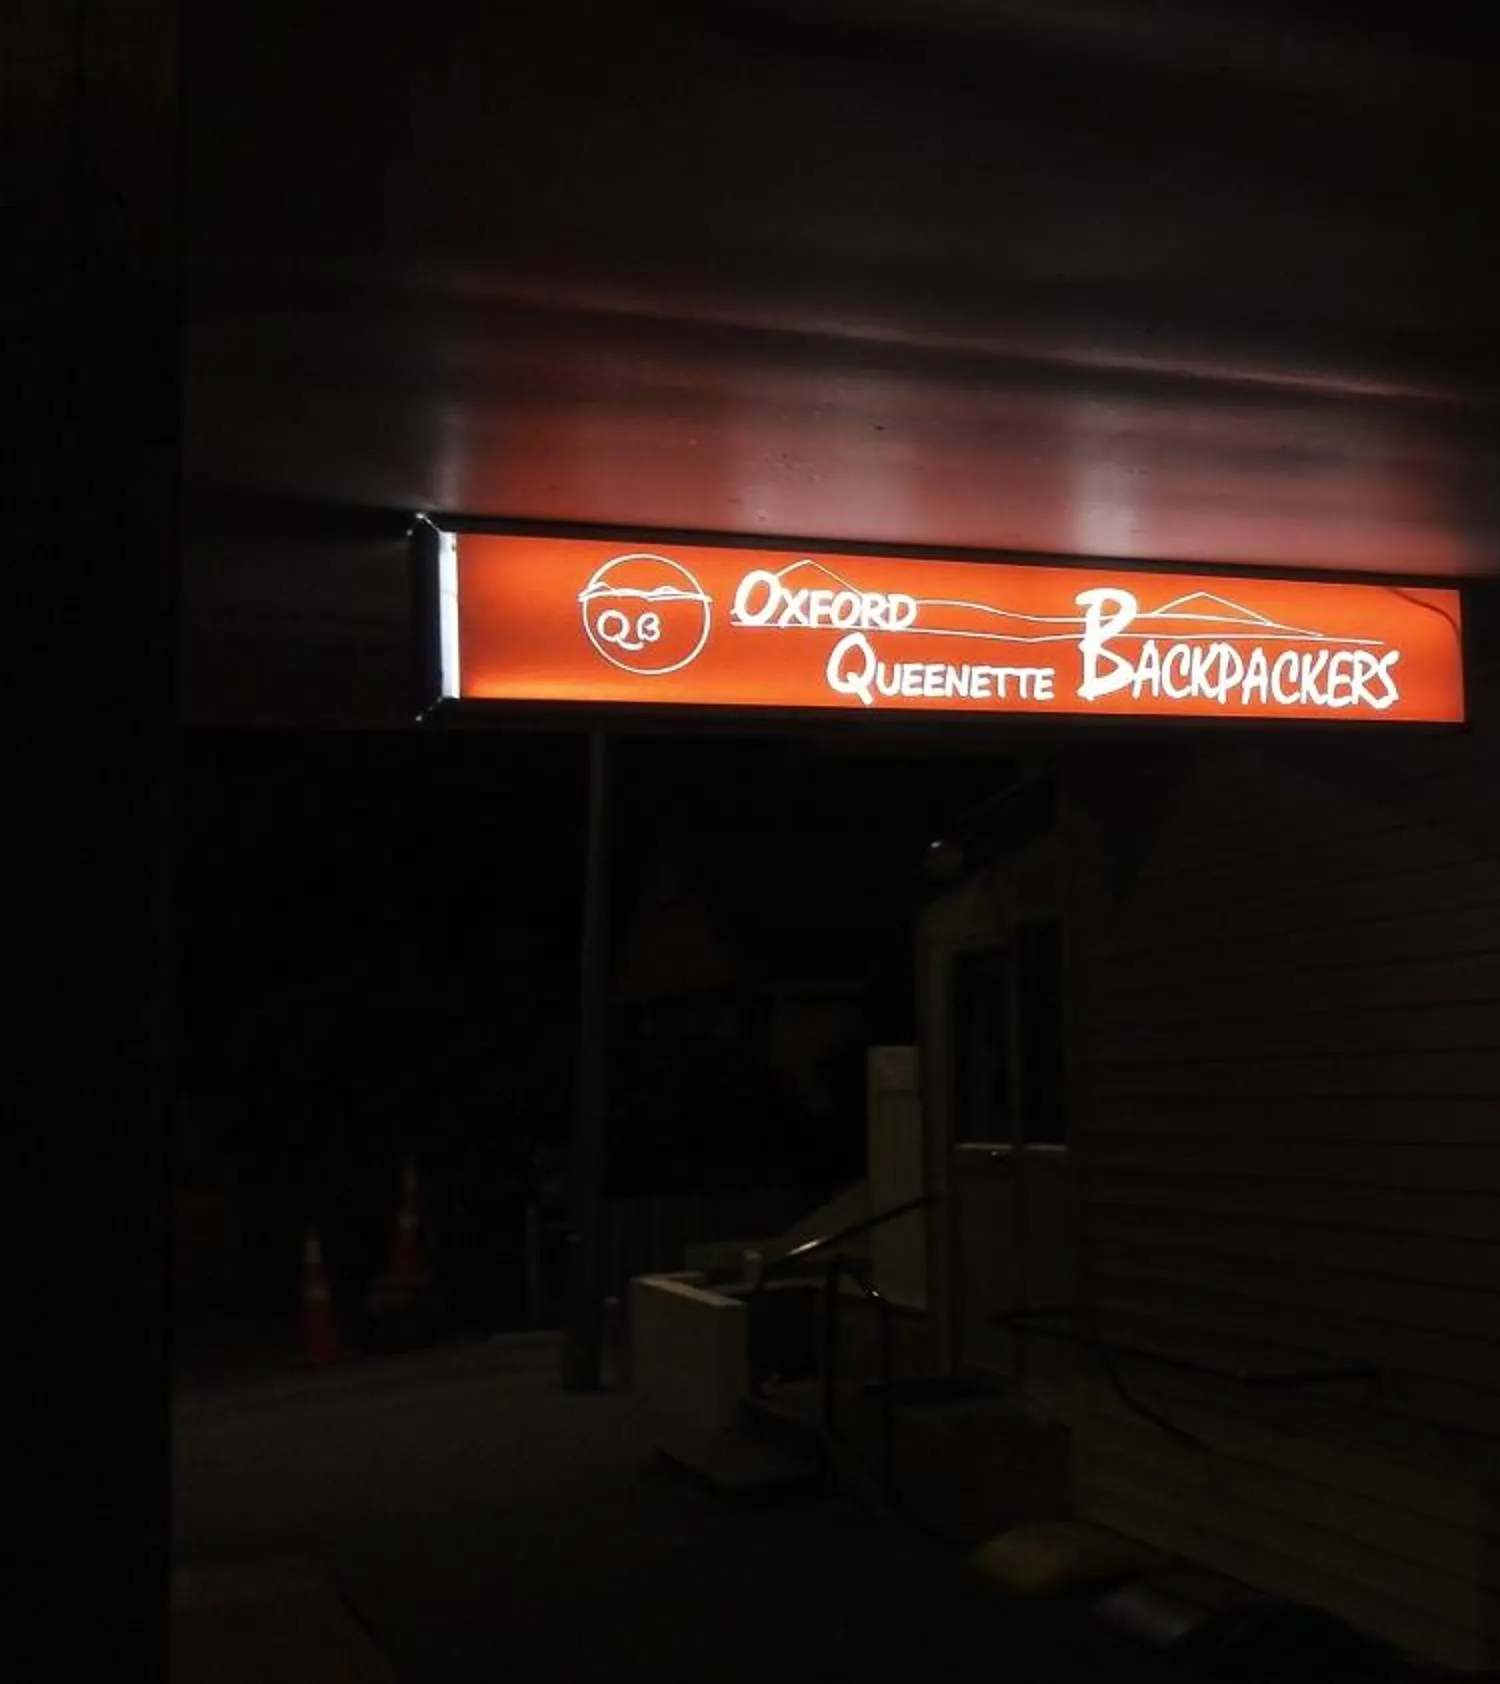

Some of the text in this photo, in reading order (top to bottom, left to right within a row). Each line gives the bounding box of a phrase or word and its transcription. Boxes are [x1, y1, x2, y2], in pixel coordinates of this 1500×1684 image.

[734, 570, 917, 631] OXFORD
[826, 587, 1400, 710] QUEENETTE BACKPACKERS
